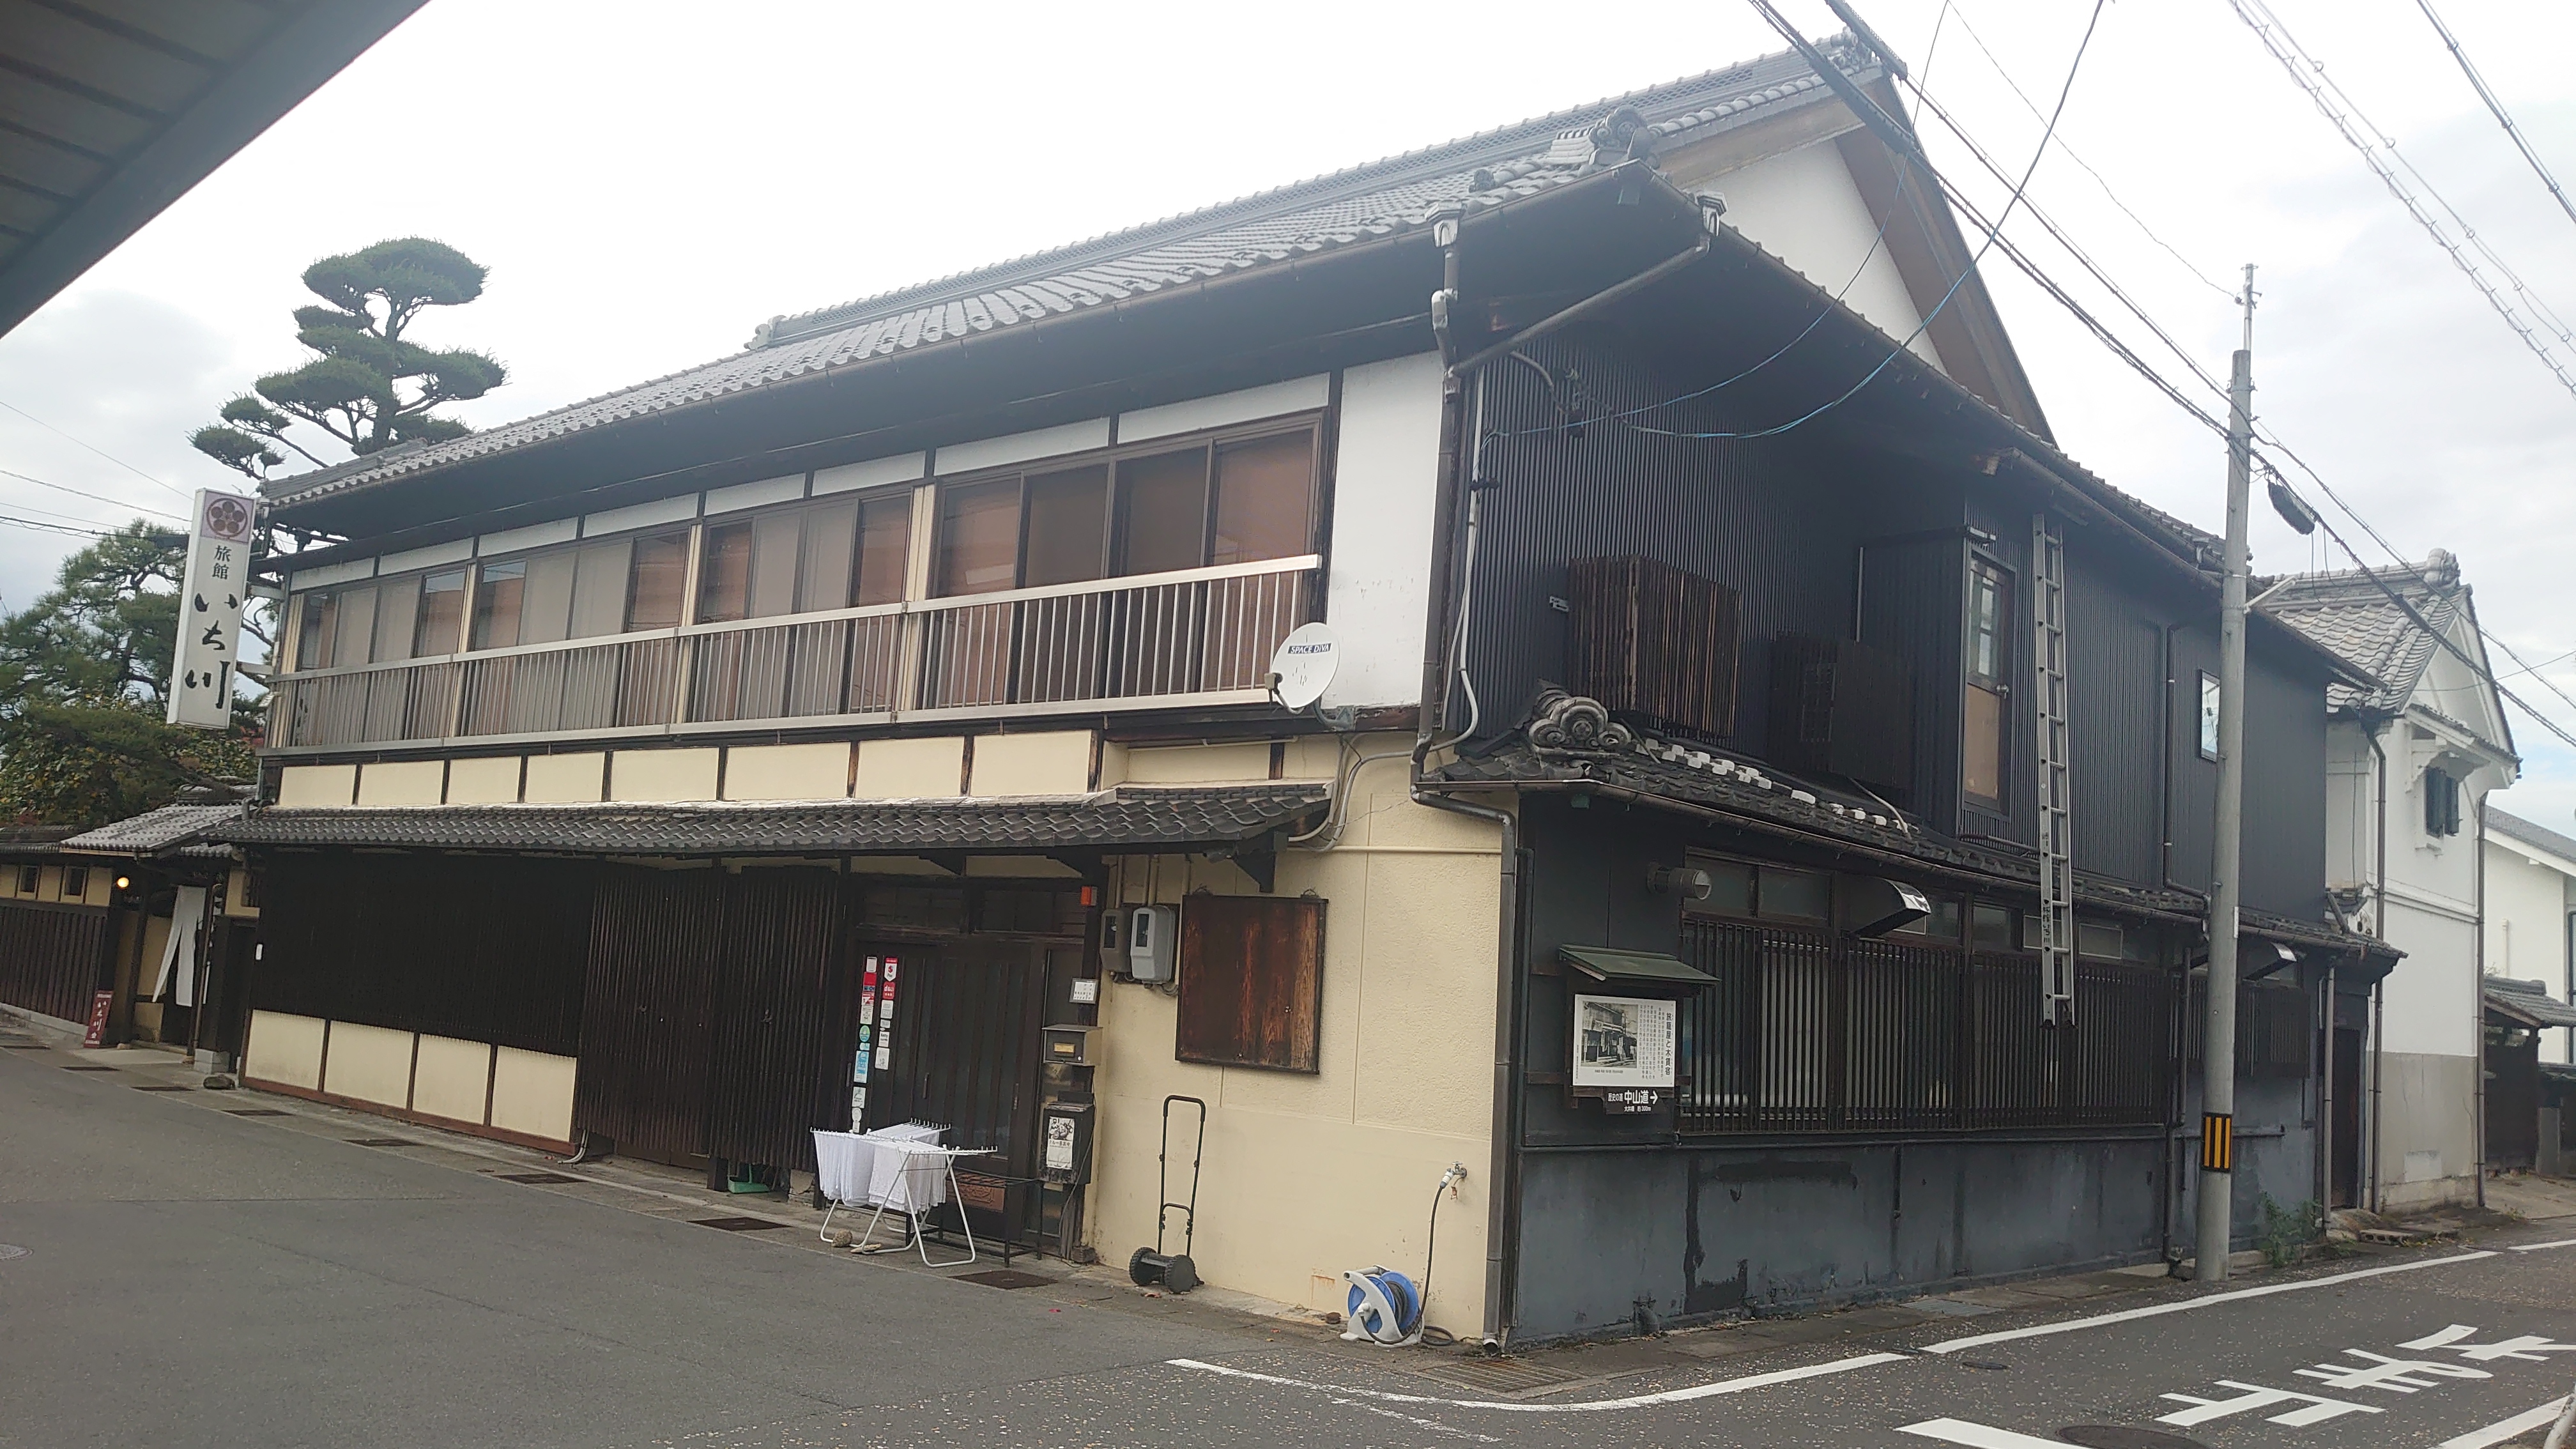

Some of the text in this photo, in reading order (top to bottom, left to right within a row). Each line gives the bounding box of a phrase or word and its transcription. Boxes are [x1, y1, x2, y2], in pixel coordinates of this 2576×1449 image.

[185, 545, 238, 709] 旅館 いち川
[1291, 645, 1312, 654] SPACE
[1624, 1089, 1648, 1105] 中山道
[2155, 1324, 2576, 1427] 止まれ
